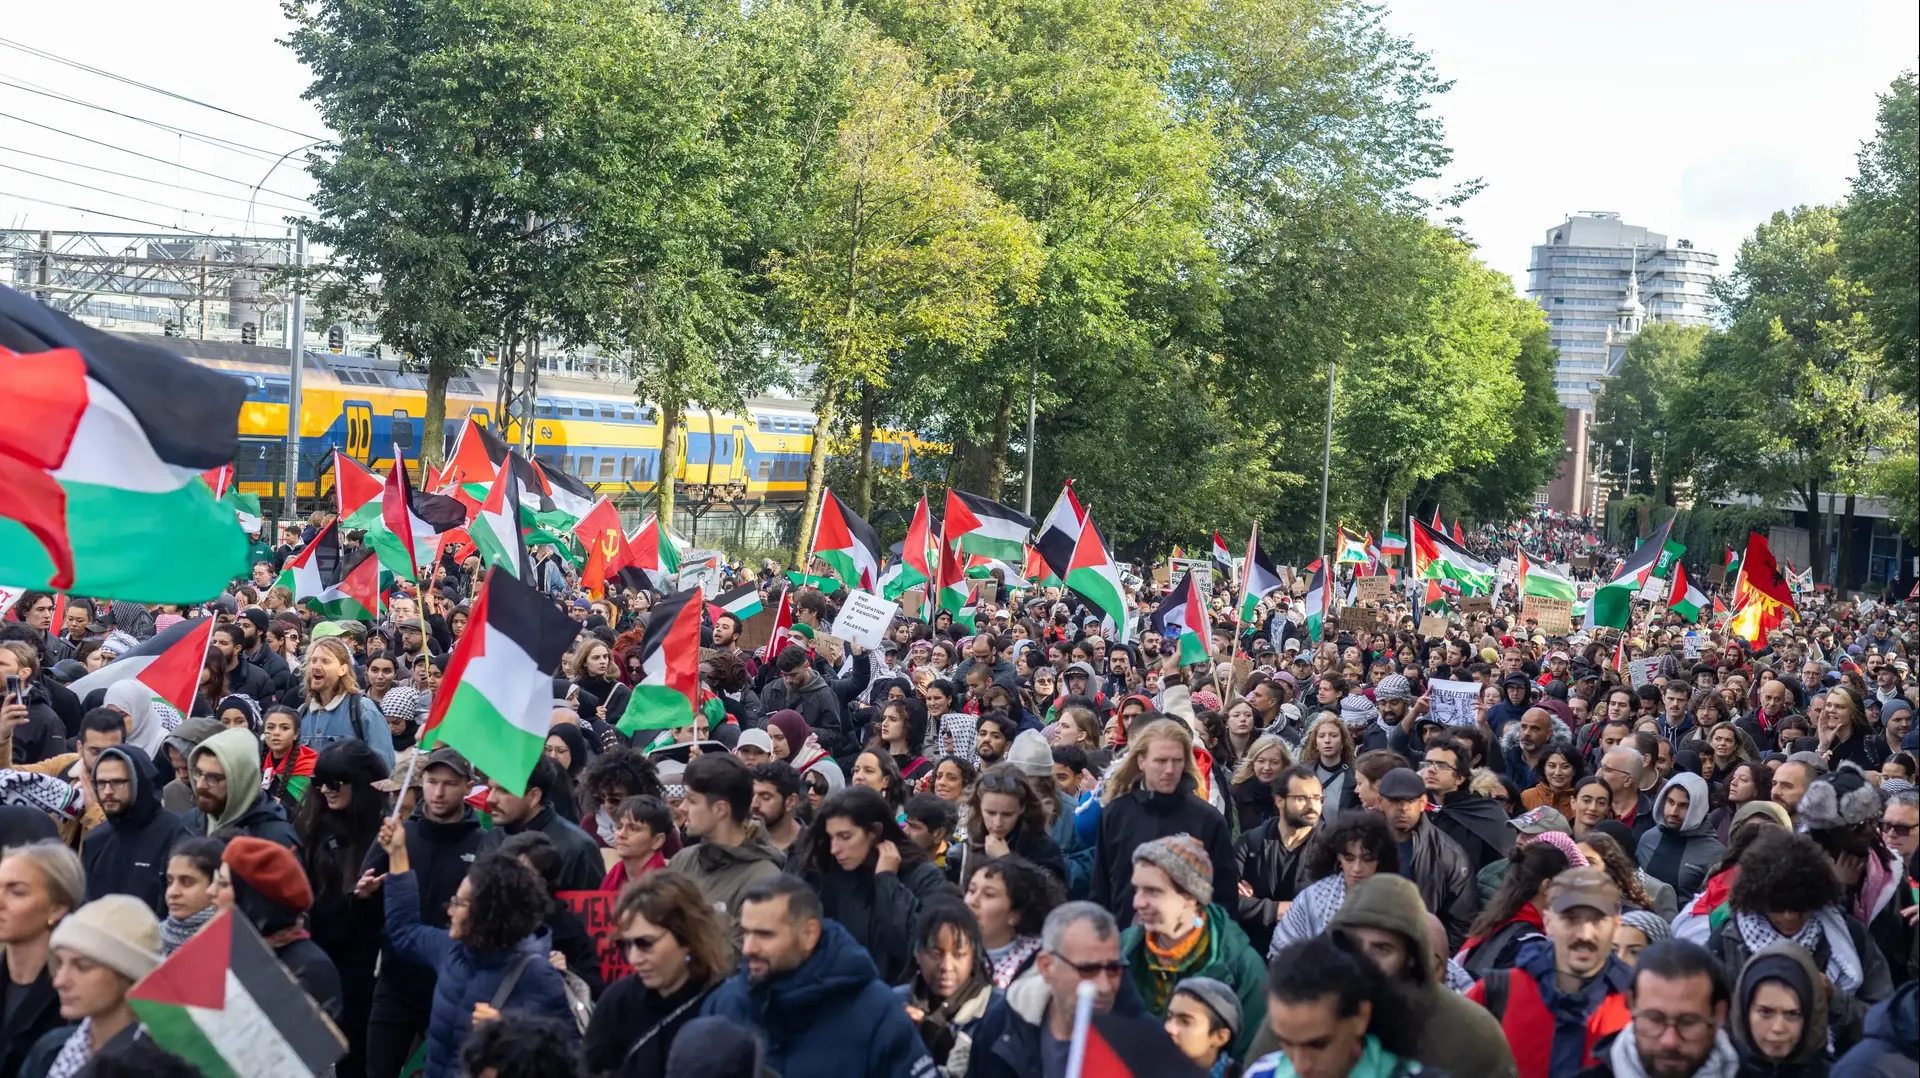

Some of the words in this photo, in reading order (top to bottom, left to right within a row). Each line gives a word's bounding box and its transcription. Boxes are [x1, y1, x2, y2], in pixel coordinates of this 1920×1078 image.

[256, 376, 264, 388] 2
[260, 446, 266, 460] 2
[855, 602, 885, 616] OCCUPATION
[856, 609, 880, 620] GENOCIDE
[843, 621, 869, 634] PALESTINE
